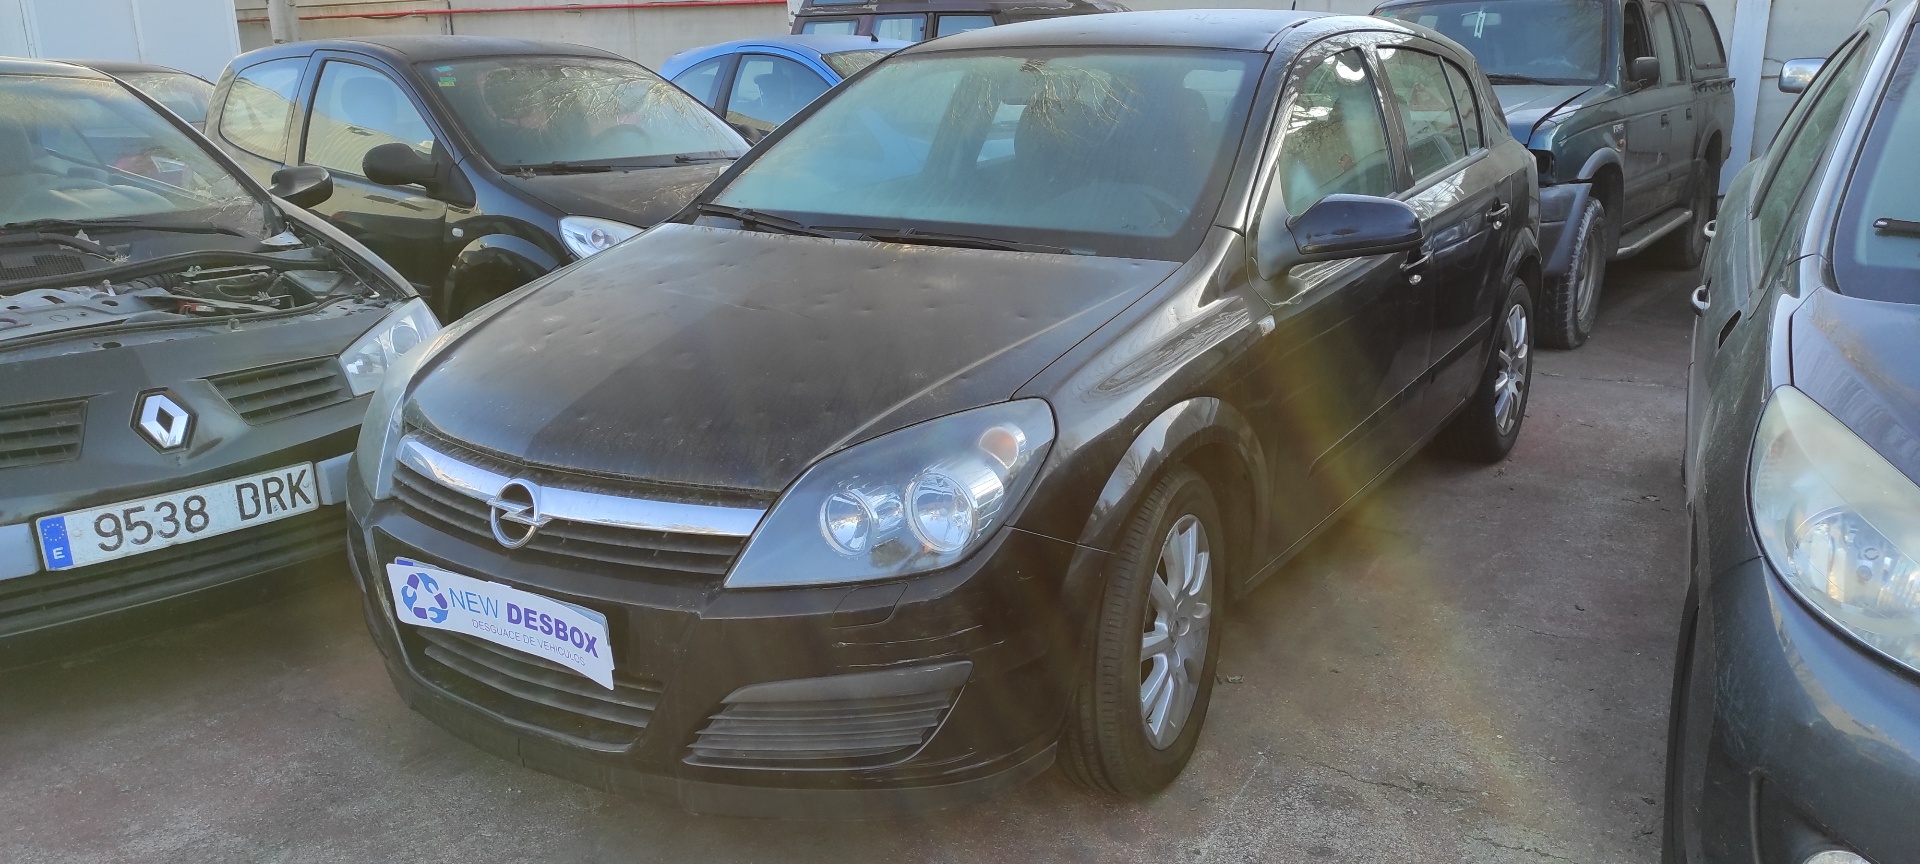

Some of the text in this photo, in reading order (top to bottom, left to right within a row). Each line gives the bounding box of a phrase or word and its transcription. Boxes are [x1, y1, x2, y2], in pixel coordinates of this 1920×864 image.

[93, 469, 312, 552] 9538 DRK
[53, 547, 65, 560] E
[449, 587, 599, 658] NEW DESBOX
[472, 618, 521, 642] DESGUACE
[523, 634, 537, 647] DE
